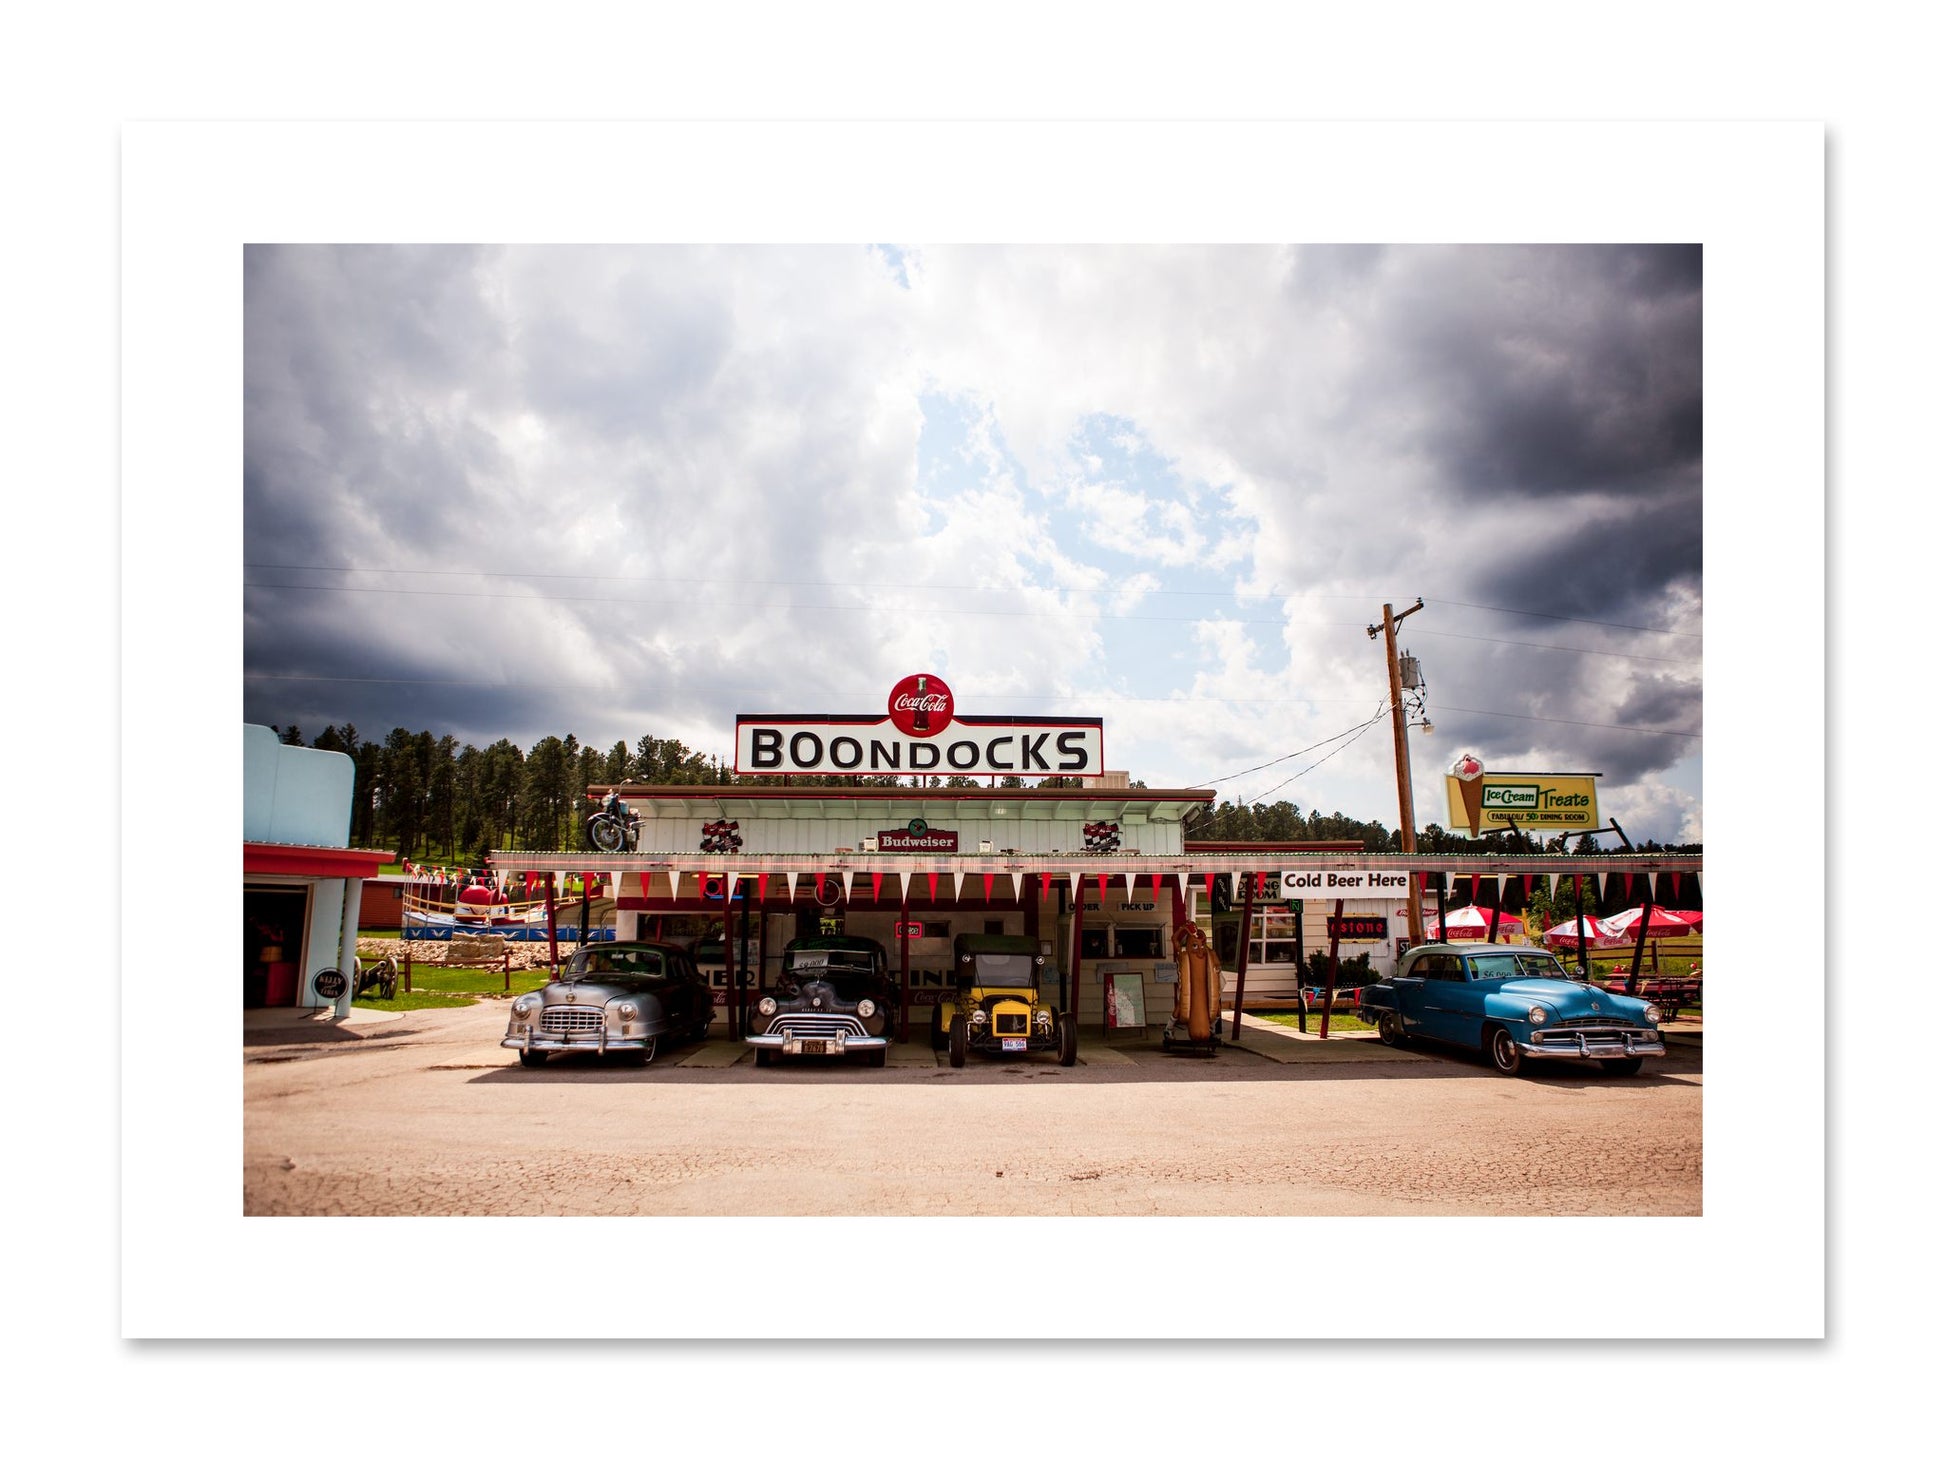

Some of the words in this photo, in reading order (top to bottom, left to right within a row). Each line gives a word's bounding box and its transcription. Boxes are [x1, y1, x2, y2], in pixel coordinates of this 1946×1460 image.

[894, 693, 949, 712] Coca-Cola
[751, 728, 1088, 771] BOONDOCKS
[1486, 790, 1502, 802] Ice
[1502, 789, 1535, 804] Cream
[1540, 789, 1589, 809] Treats
[1540, 813, 1563, 821] DINING
[1564, 813, 1585, 821] ROOM
[881, 836, 954, 847] Budweiser
[1284, 873, 1321, 888] Cold
[1327, 873, 1363, 888] Beer
[1368, 873, 1407, 888] Here
[1068, 903, 1100, 911] ODER
[1121, 903, 1143, 911] PICK
[1144, 903, 1155, 911] UP
